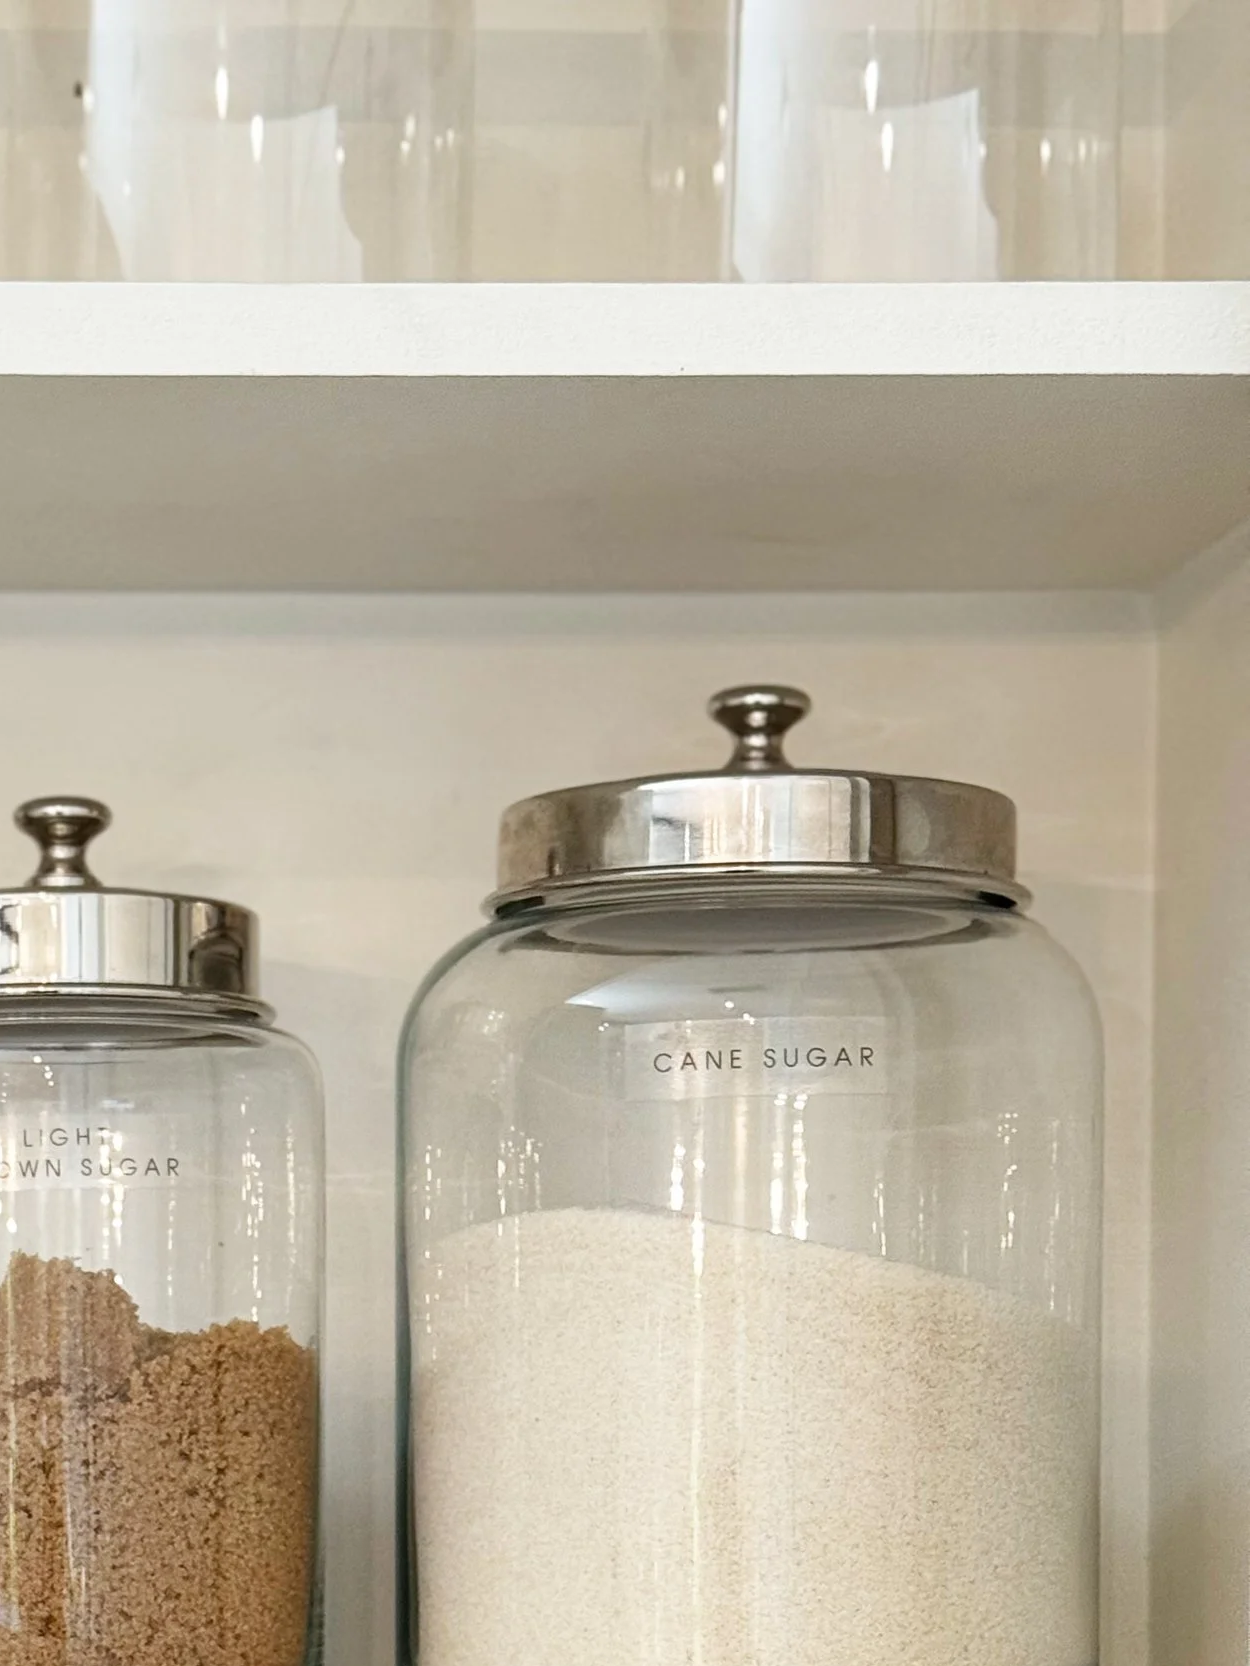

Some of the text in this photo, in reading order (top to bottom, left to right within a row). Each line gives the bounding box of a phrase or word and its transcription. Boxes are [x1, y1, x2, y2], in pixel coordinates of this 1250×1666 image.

[653, 1046, 875, 1073] CANE SUGAR
[23, 1127, 108, 1148] LIGHT
[80, 1158, 179, 1177] SUGAR
